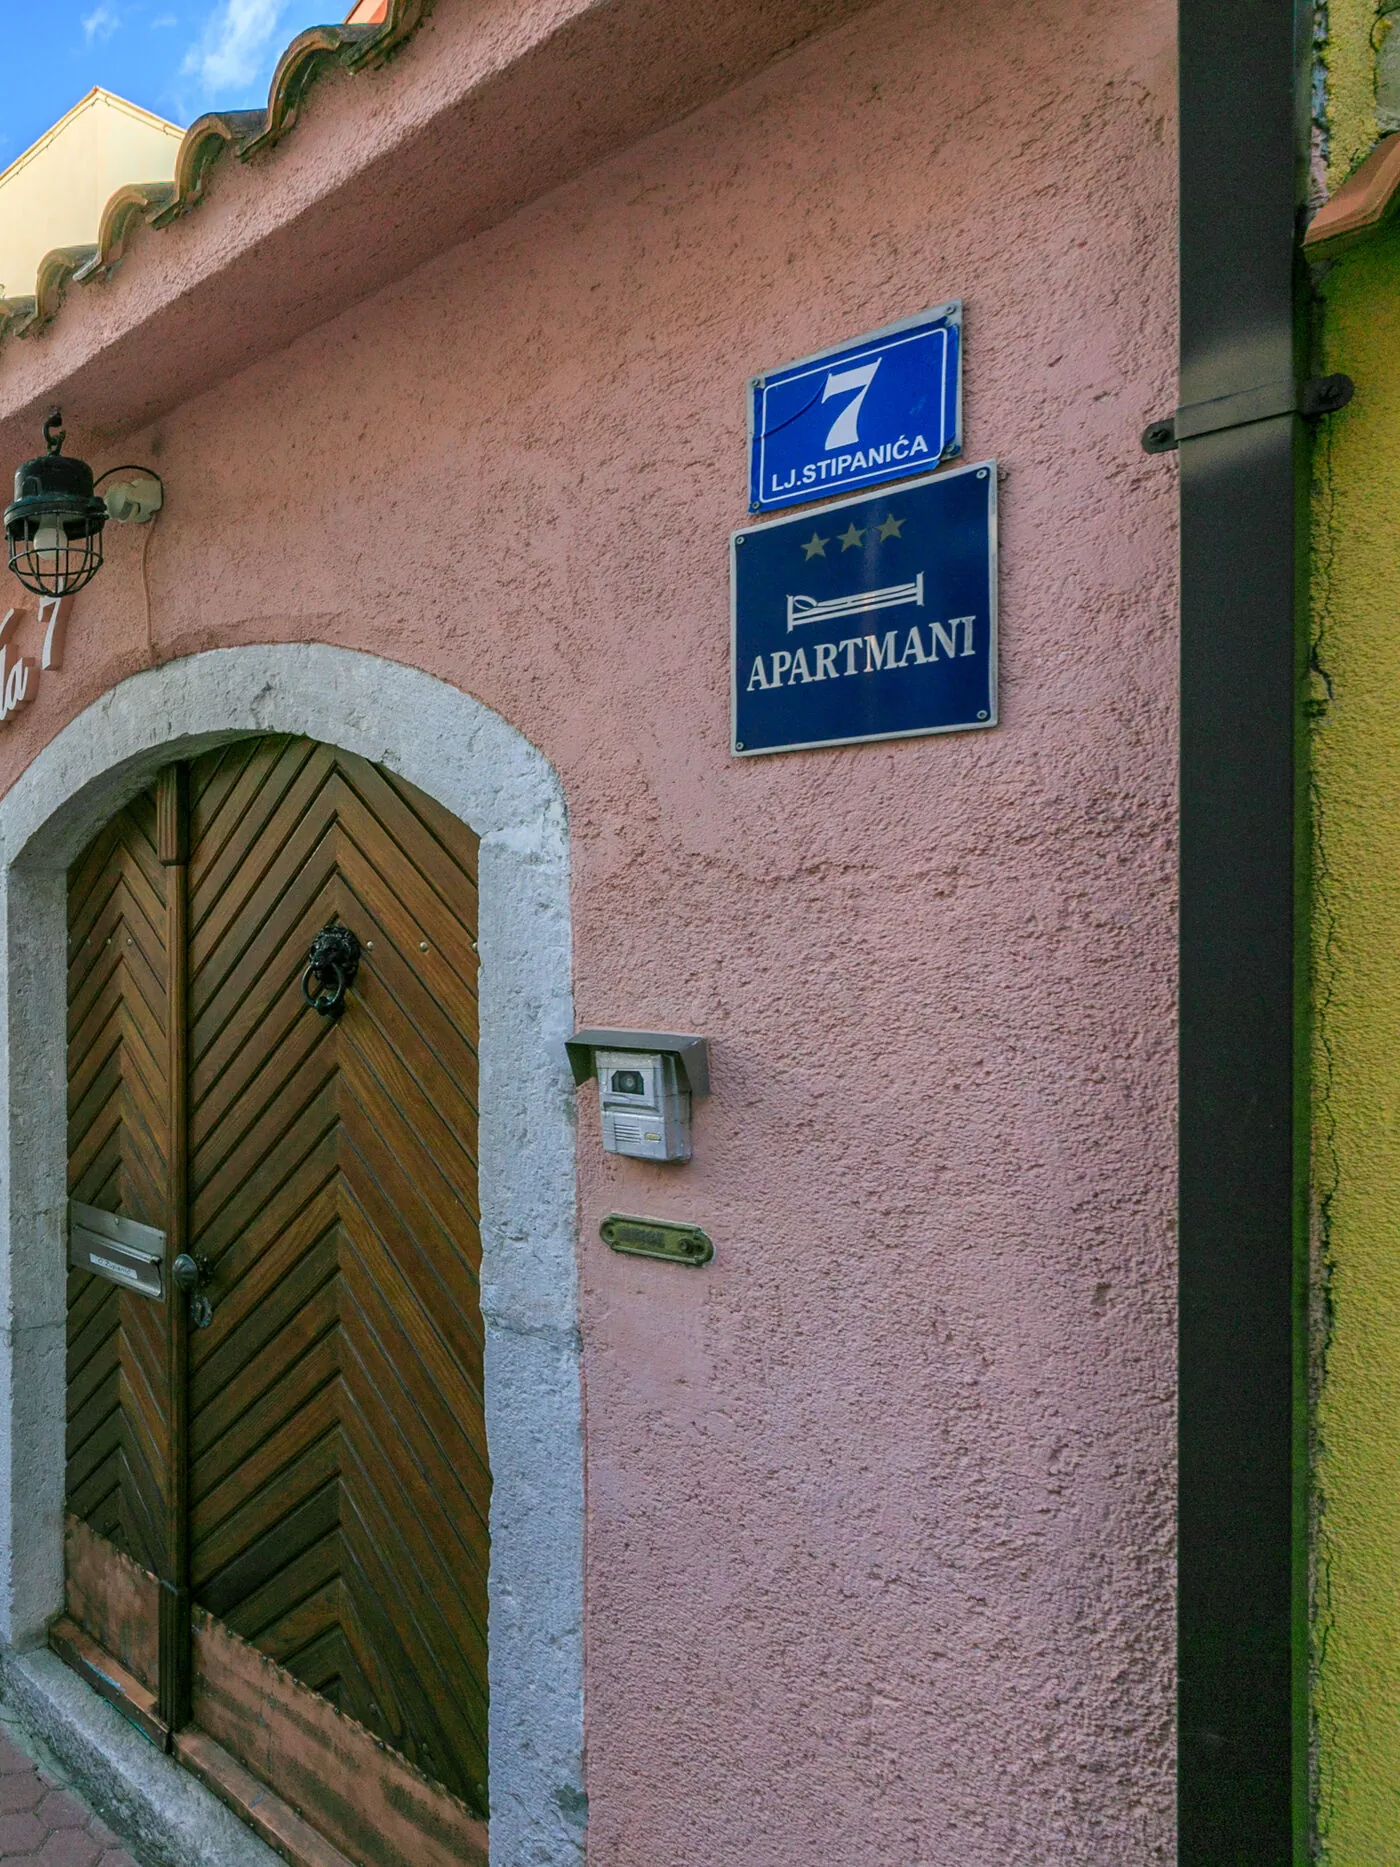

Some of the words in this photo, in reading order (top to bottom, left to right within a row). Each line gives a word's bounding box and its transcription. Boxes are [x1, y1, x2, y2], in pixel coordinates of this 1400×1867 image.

[822, 356, 882, 451] 7
[37, 576, 67, 670] 7
[746, 615, 977, 692] APARTMANI
